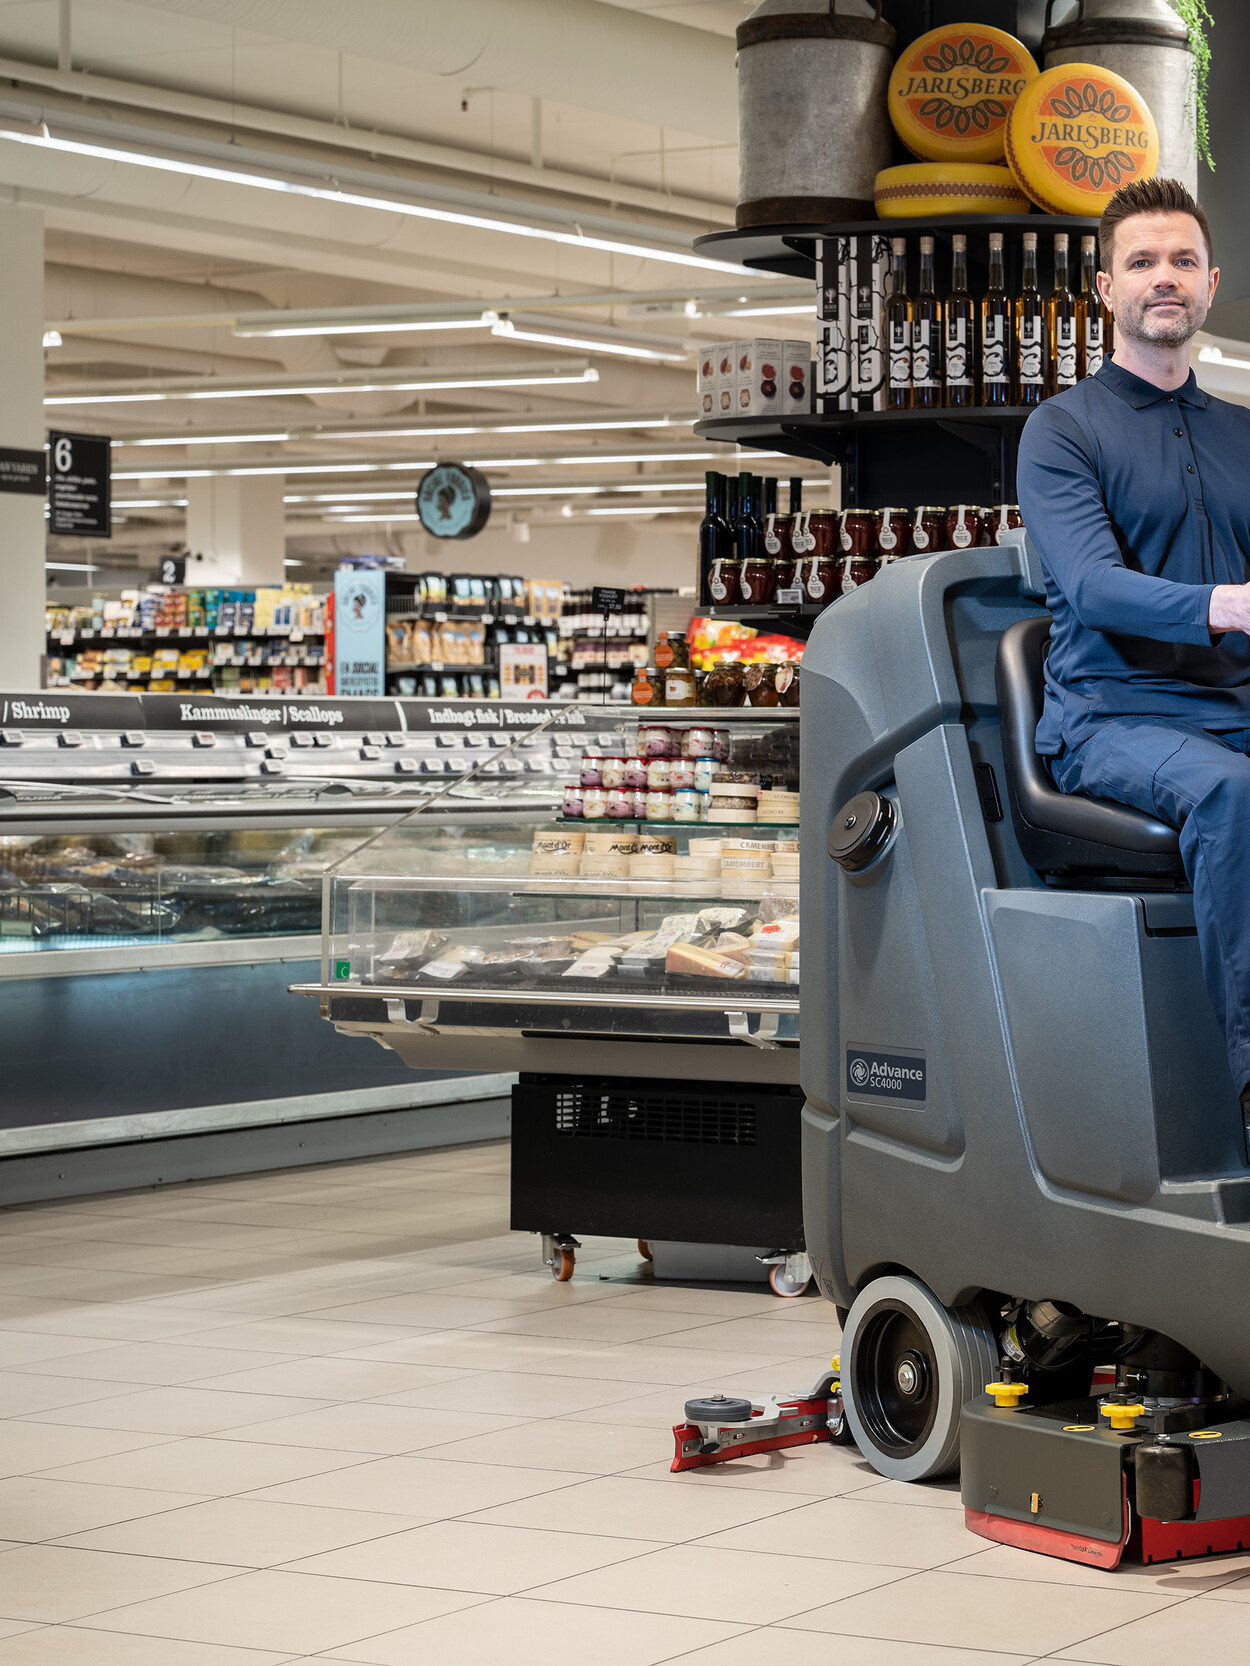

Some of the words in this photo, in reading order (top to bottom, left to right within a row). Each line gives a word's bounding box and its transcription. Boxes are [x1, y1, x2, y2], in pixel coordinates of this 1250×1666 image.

[898, 77, 1026, 100] JARLSBERG
[1031, 122, 1149, 149] JARLSBERG
[55, 438, 73, 472] 6
[162, 560, 176, 584] 2
[11, 701, 71, 723] Shrimp
[180, 704, 281, 725] Kammuslinger
[288, 706, 344, 726] Scallops
[428, 708, 474, 727] Indbagt
[475, 708, 499, 724] fisk
[870, 1061, 923, 1081] Advance
[870, 1076, 902, 1090] SC4000
